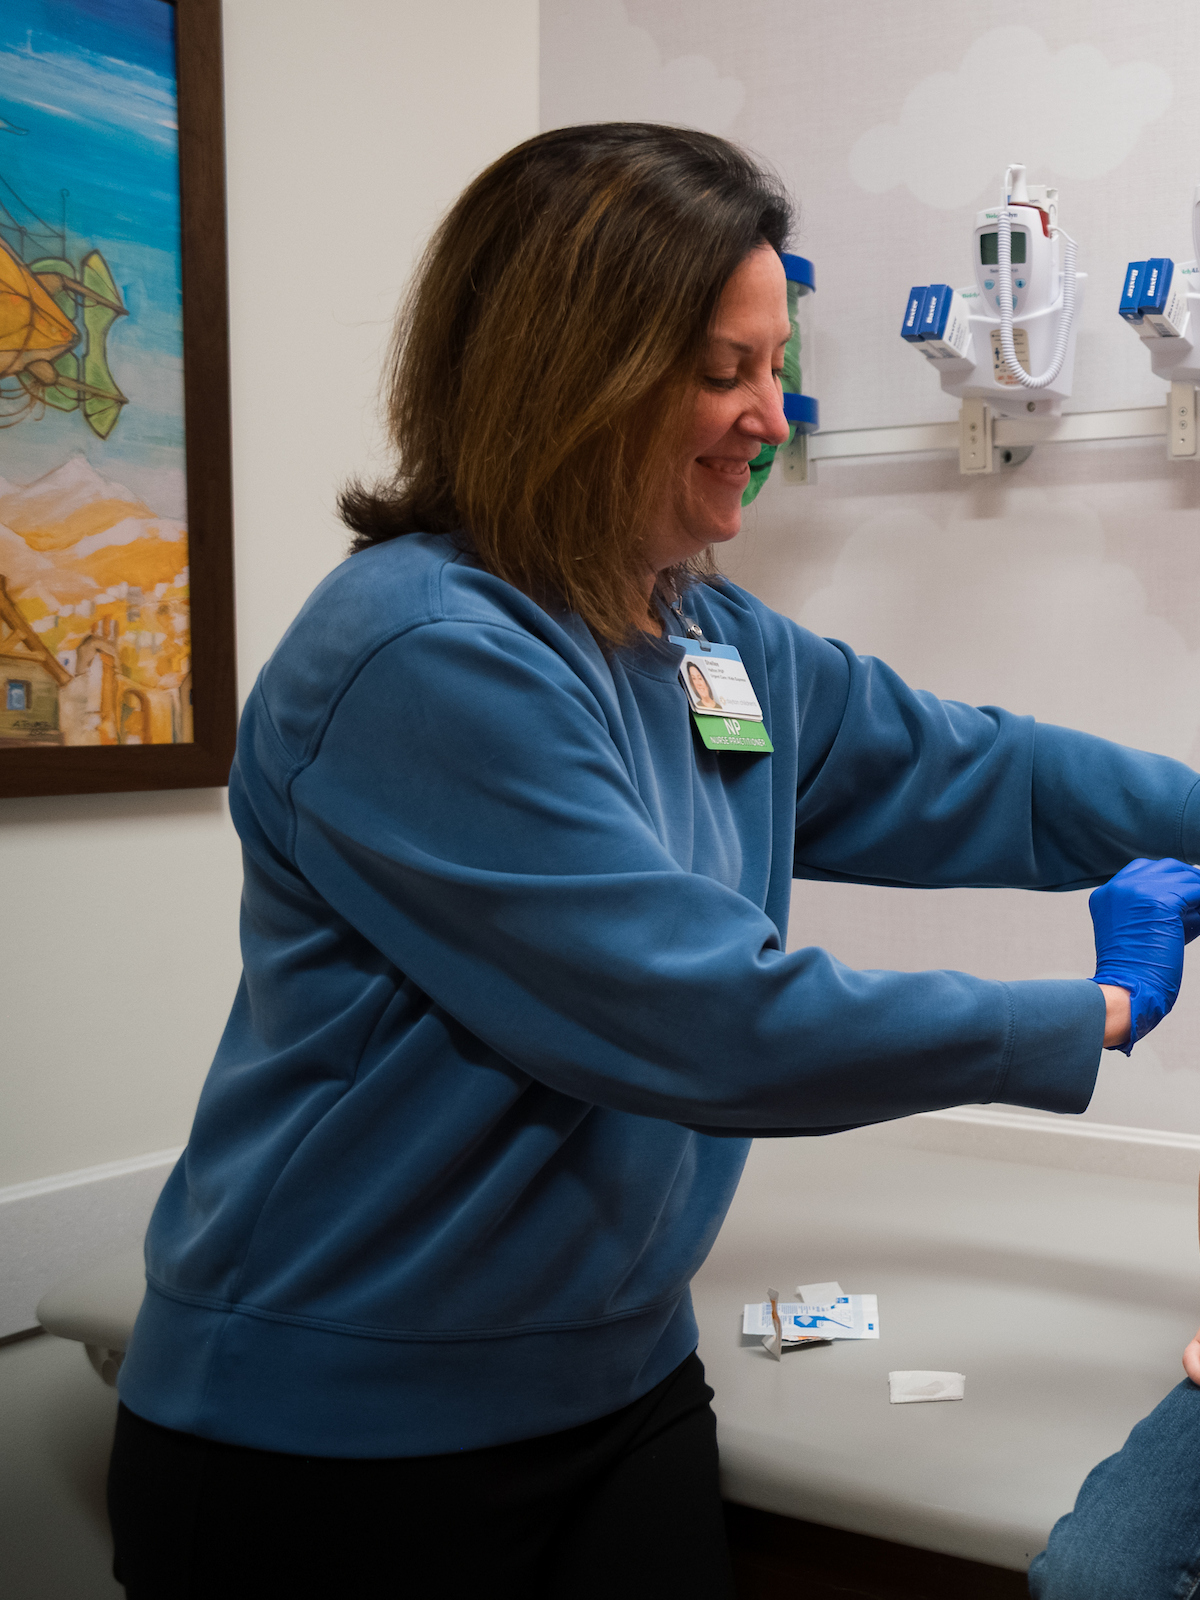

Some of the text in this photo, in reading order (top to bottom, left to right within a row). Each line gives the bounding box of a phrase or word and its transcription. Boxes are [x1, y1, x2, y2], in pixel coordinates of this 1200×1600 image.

[1127, 269, 1139, 298] Baxter
[1147, 268, 1158, 297] Baxter
[906, 299, 918, 327] Baxter
[926, 296, 937, 324] Baxter
[723, 718, 741, 735] NP
[709, 736, 766, 747] NURSE PRACTITIONER
